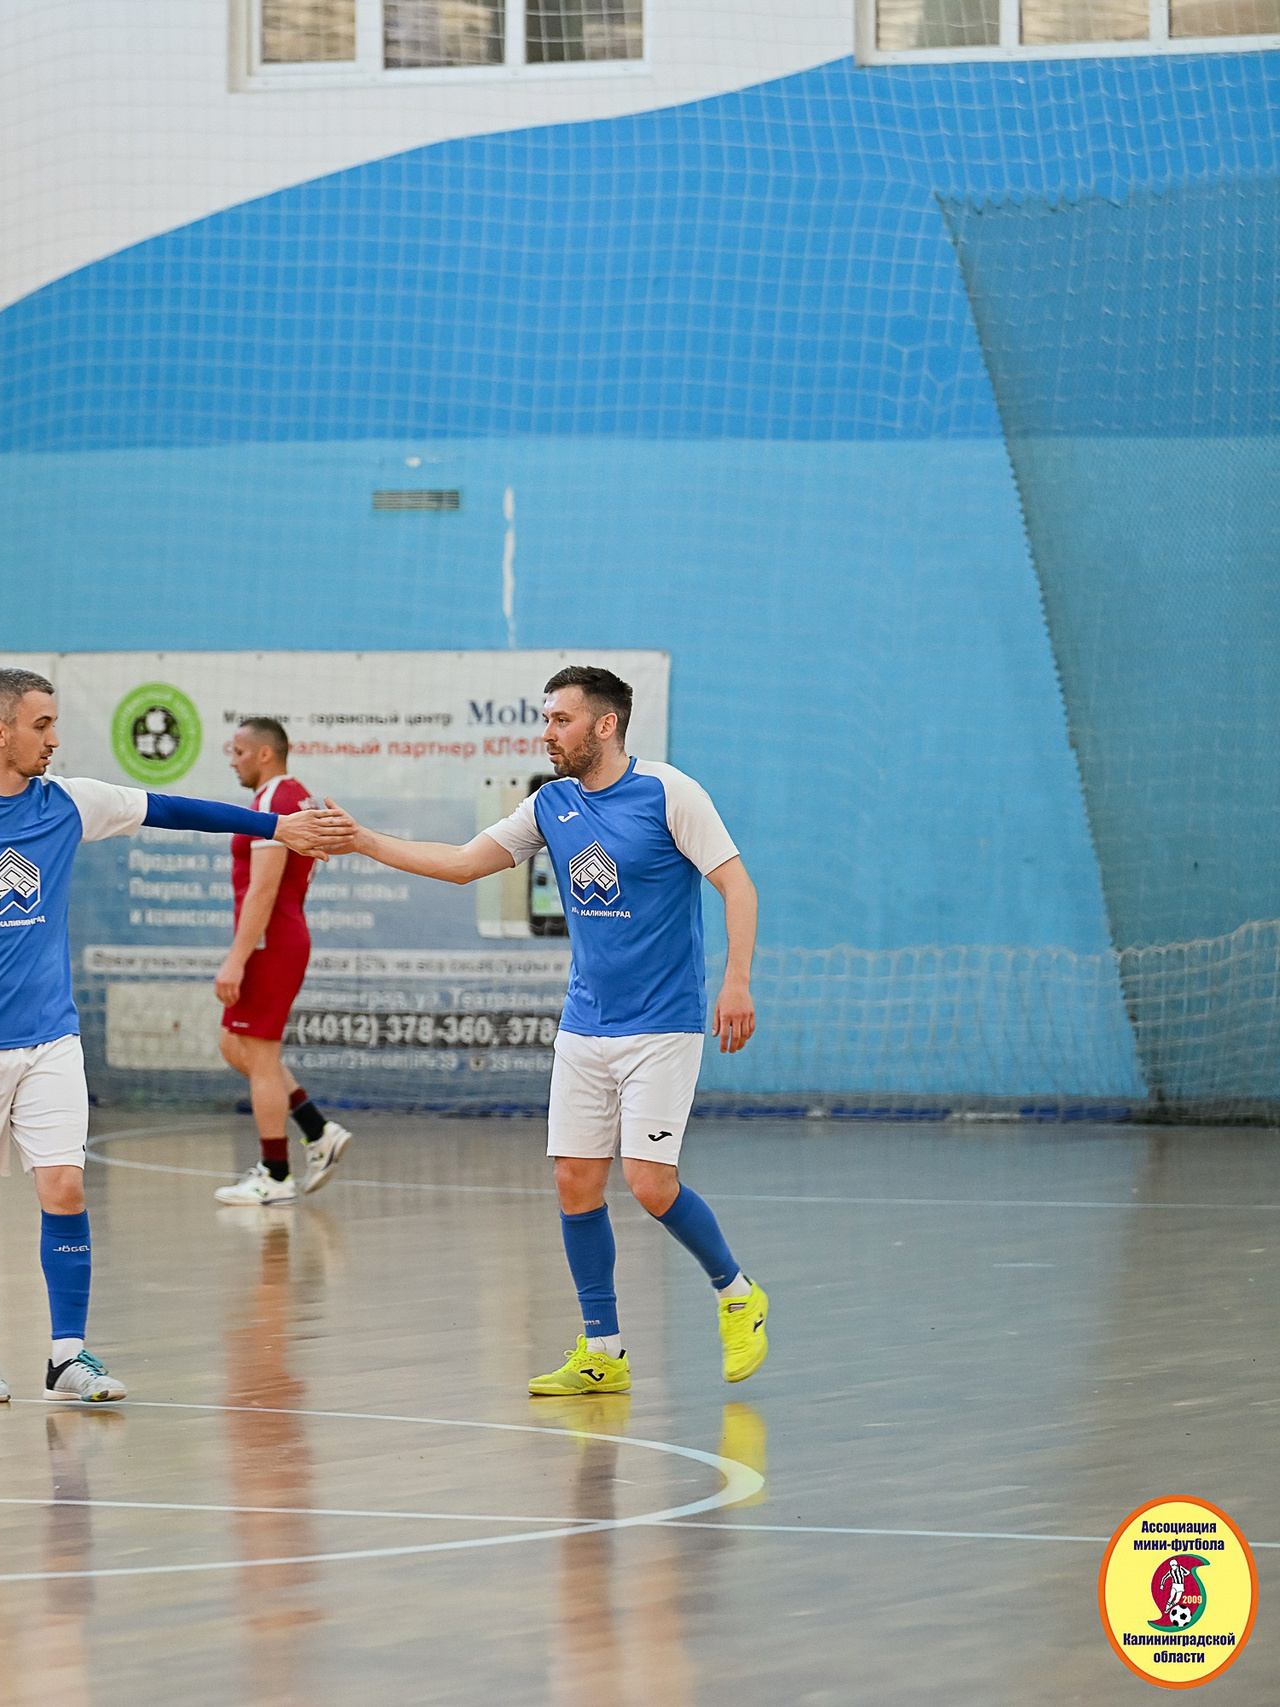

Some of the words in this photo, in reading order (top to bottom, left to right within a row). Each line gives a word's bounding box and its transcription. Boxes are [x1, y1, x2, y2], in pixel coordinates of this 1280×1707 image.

[468, 697, 542, 726] Mob
[403, 713, 453, 730] центр
[387, 741, 477, 759] партнер
[580, 909, 632, 918] КАЛИНИНГРАД
[297, 1016, 378, 1047] (4012)
[507, 1016, 557, 1045] 378
